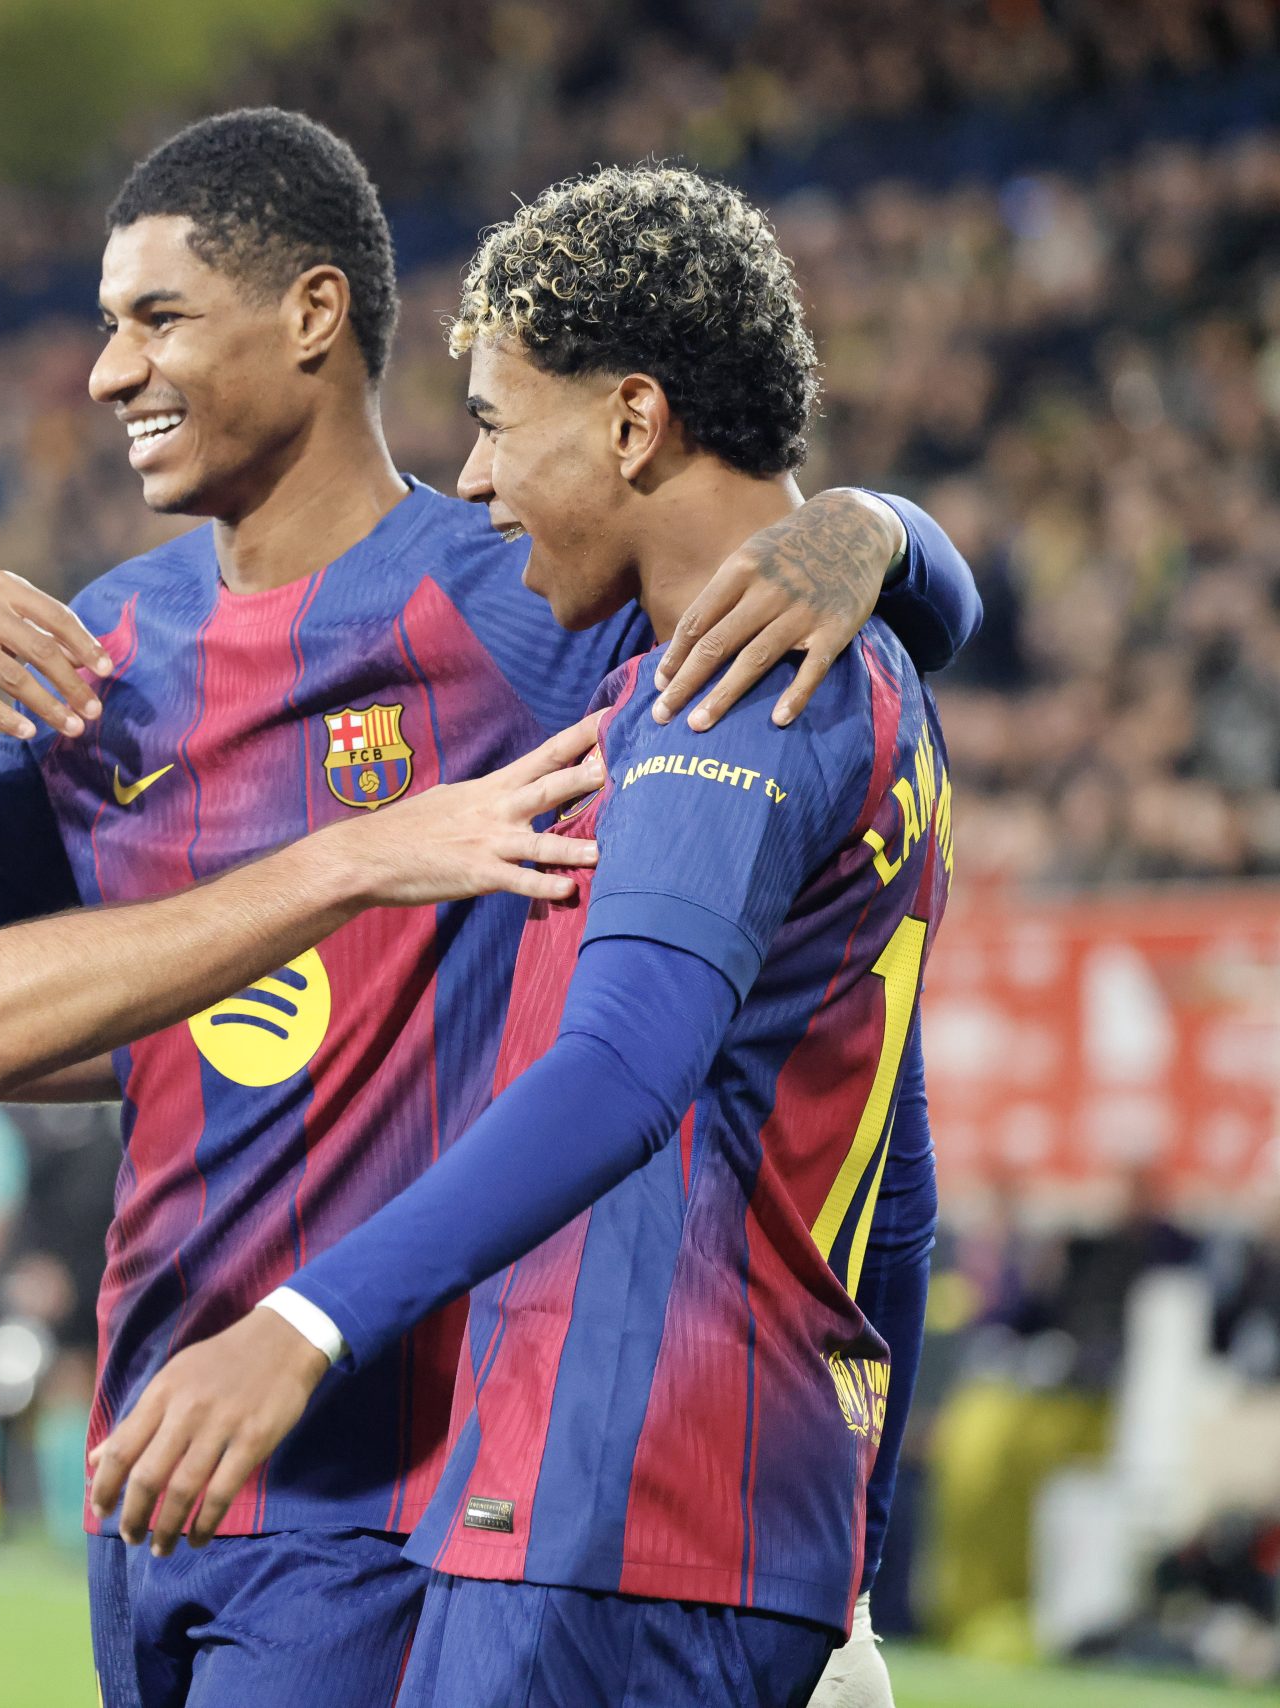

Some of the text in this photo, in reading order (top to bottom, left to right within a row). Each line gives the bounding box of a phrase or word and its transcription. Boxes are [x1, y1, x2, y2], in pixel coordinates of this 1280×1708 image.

[349, 748, 383, 764] FCB
[622, 755, 787, 804] AMBILIGHT tv
